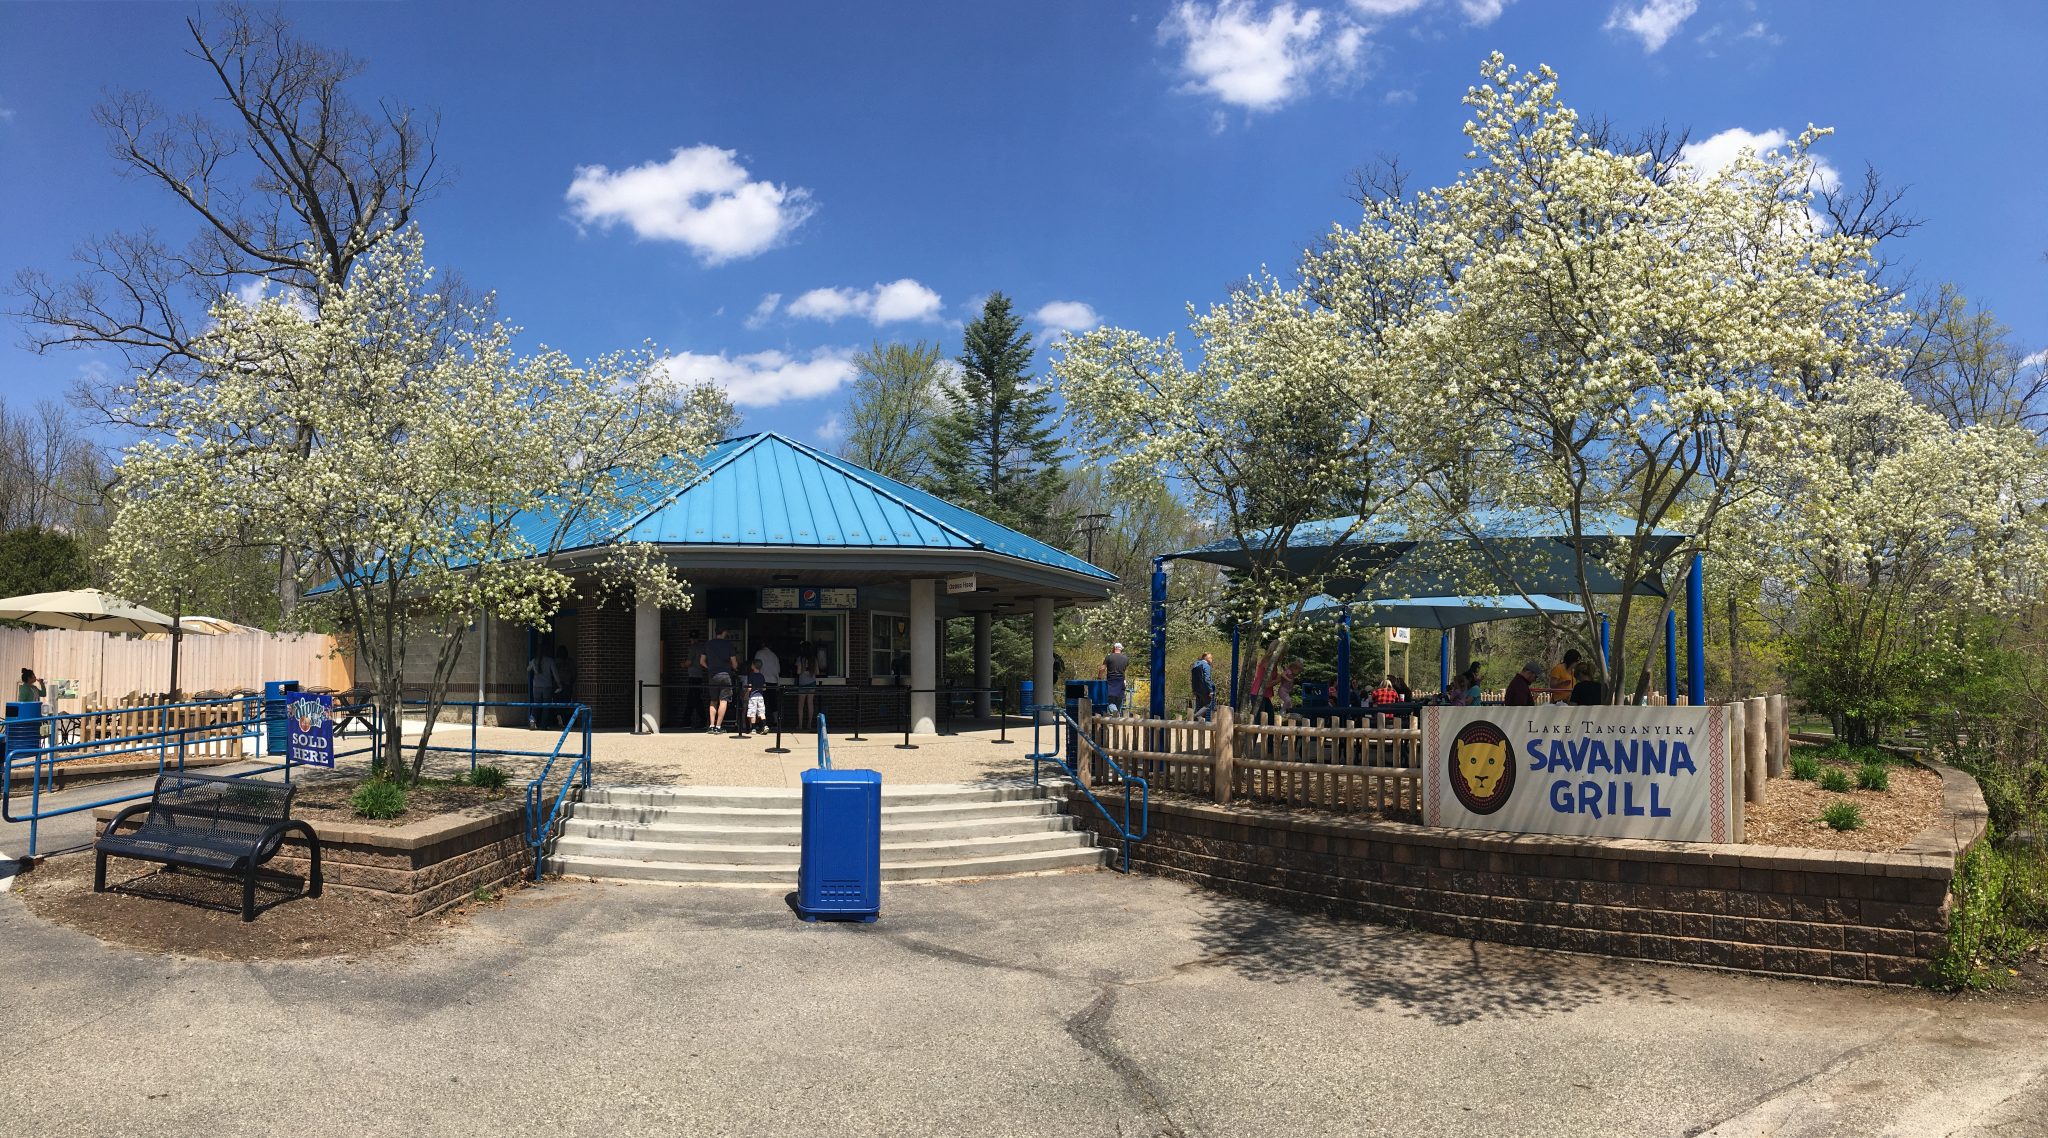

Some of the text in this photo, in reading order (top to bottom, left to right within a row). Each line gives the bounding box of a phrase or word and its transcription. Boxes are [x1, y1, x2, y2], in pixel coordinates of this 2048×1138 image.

[292, 733, 328, 749] SOLD
[293, 747, 328, 764] HERE
[1526, 737, 1697, 777] SAVANNA
[1549, 779, 1672, 820] GRILL
